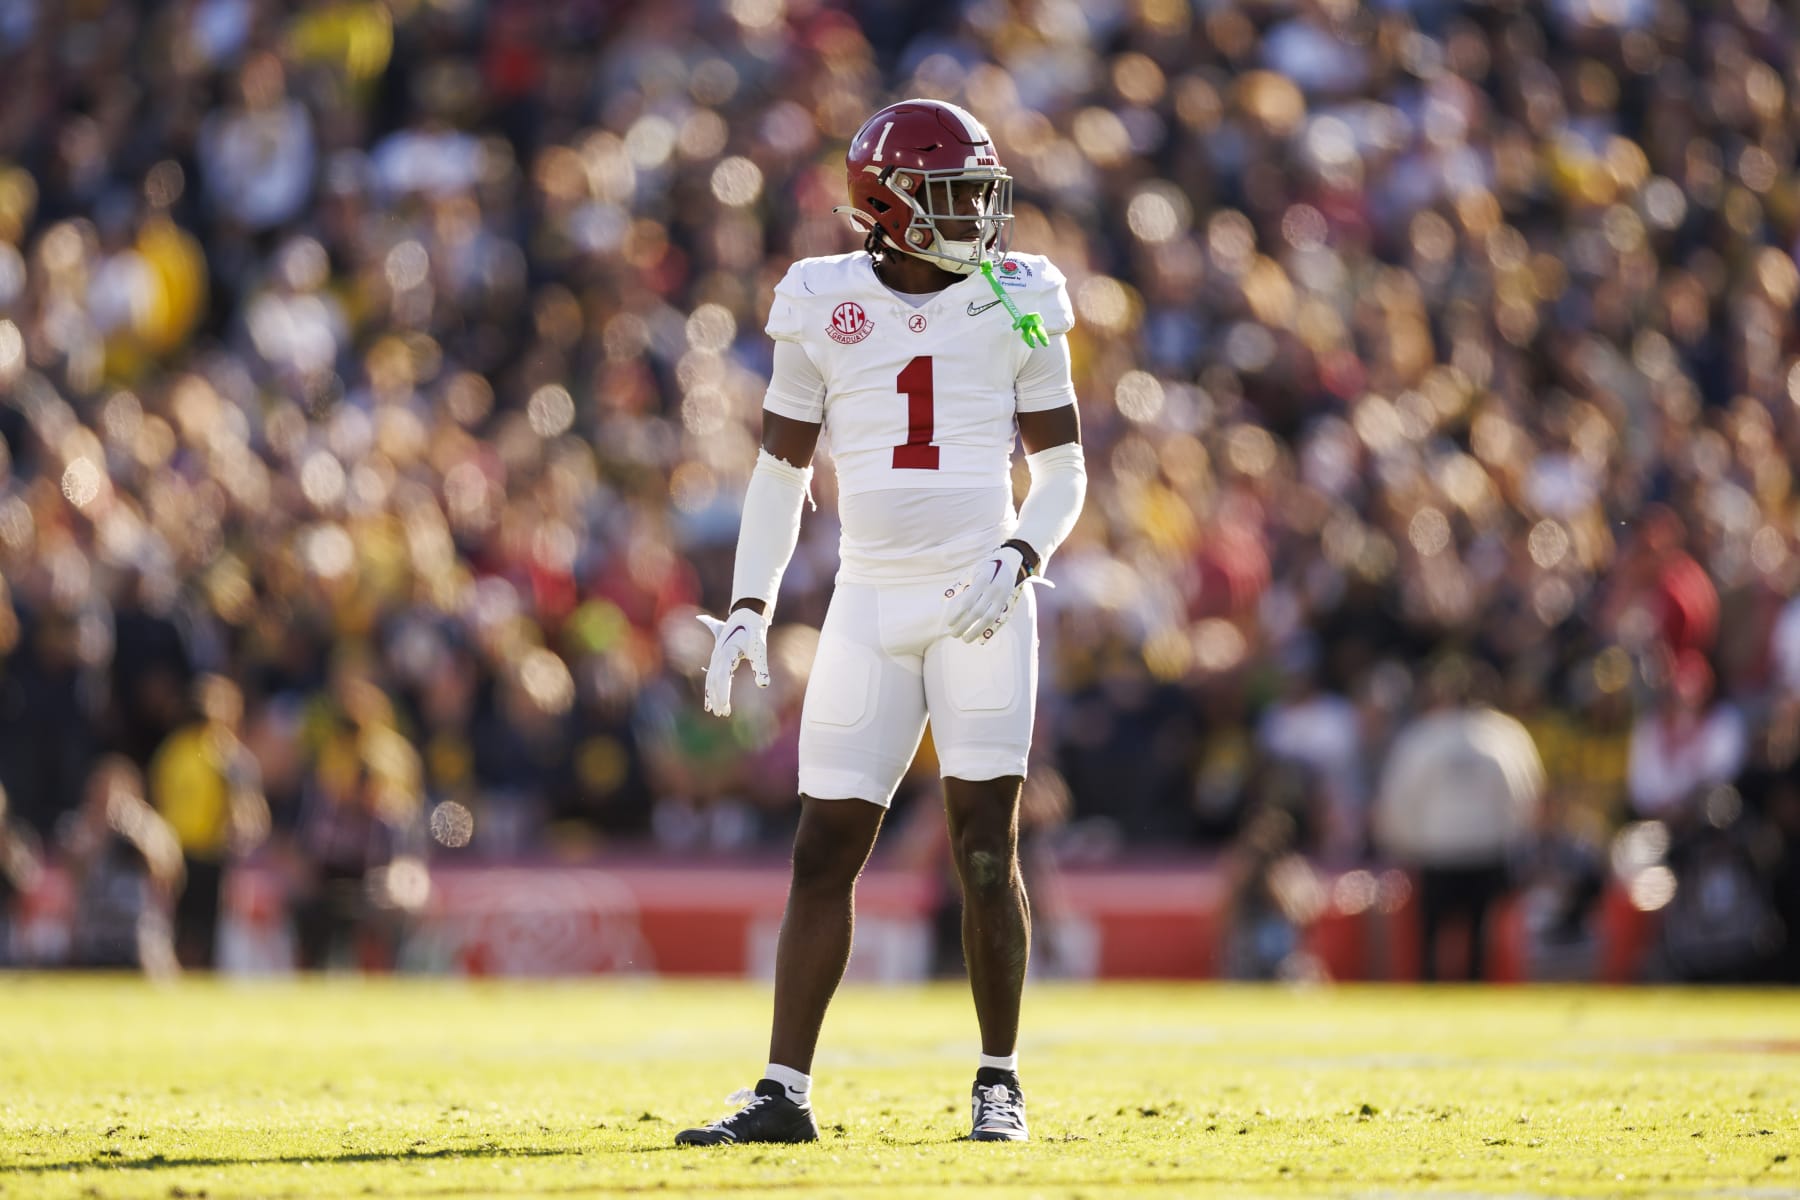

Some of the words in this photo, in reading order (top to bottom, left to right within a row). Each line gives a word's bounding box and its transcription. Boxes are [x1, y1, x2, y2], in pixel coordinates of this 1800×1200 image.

[872, 122, 894, 161] 1
[831, 327, 869, 343] GRADUATE
[833, 303, 865, 333] SEC
[892, 355, 940, 470] 1
